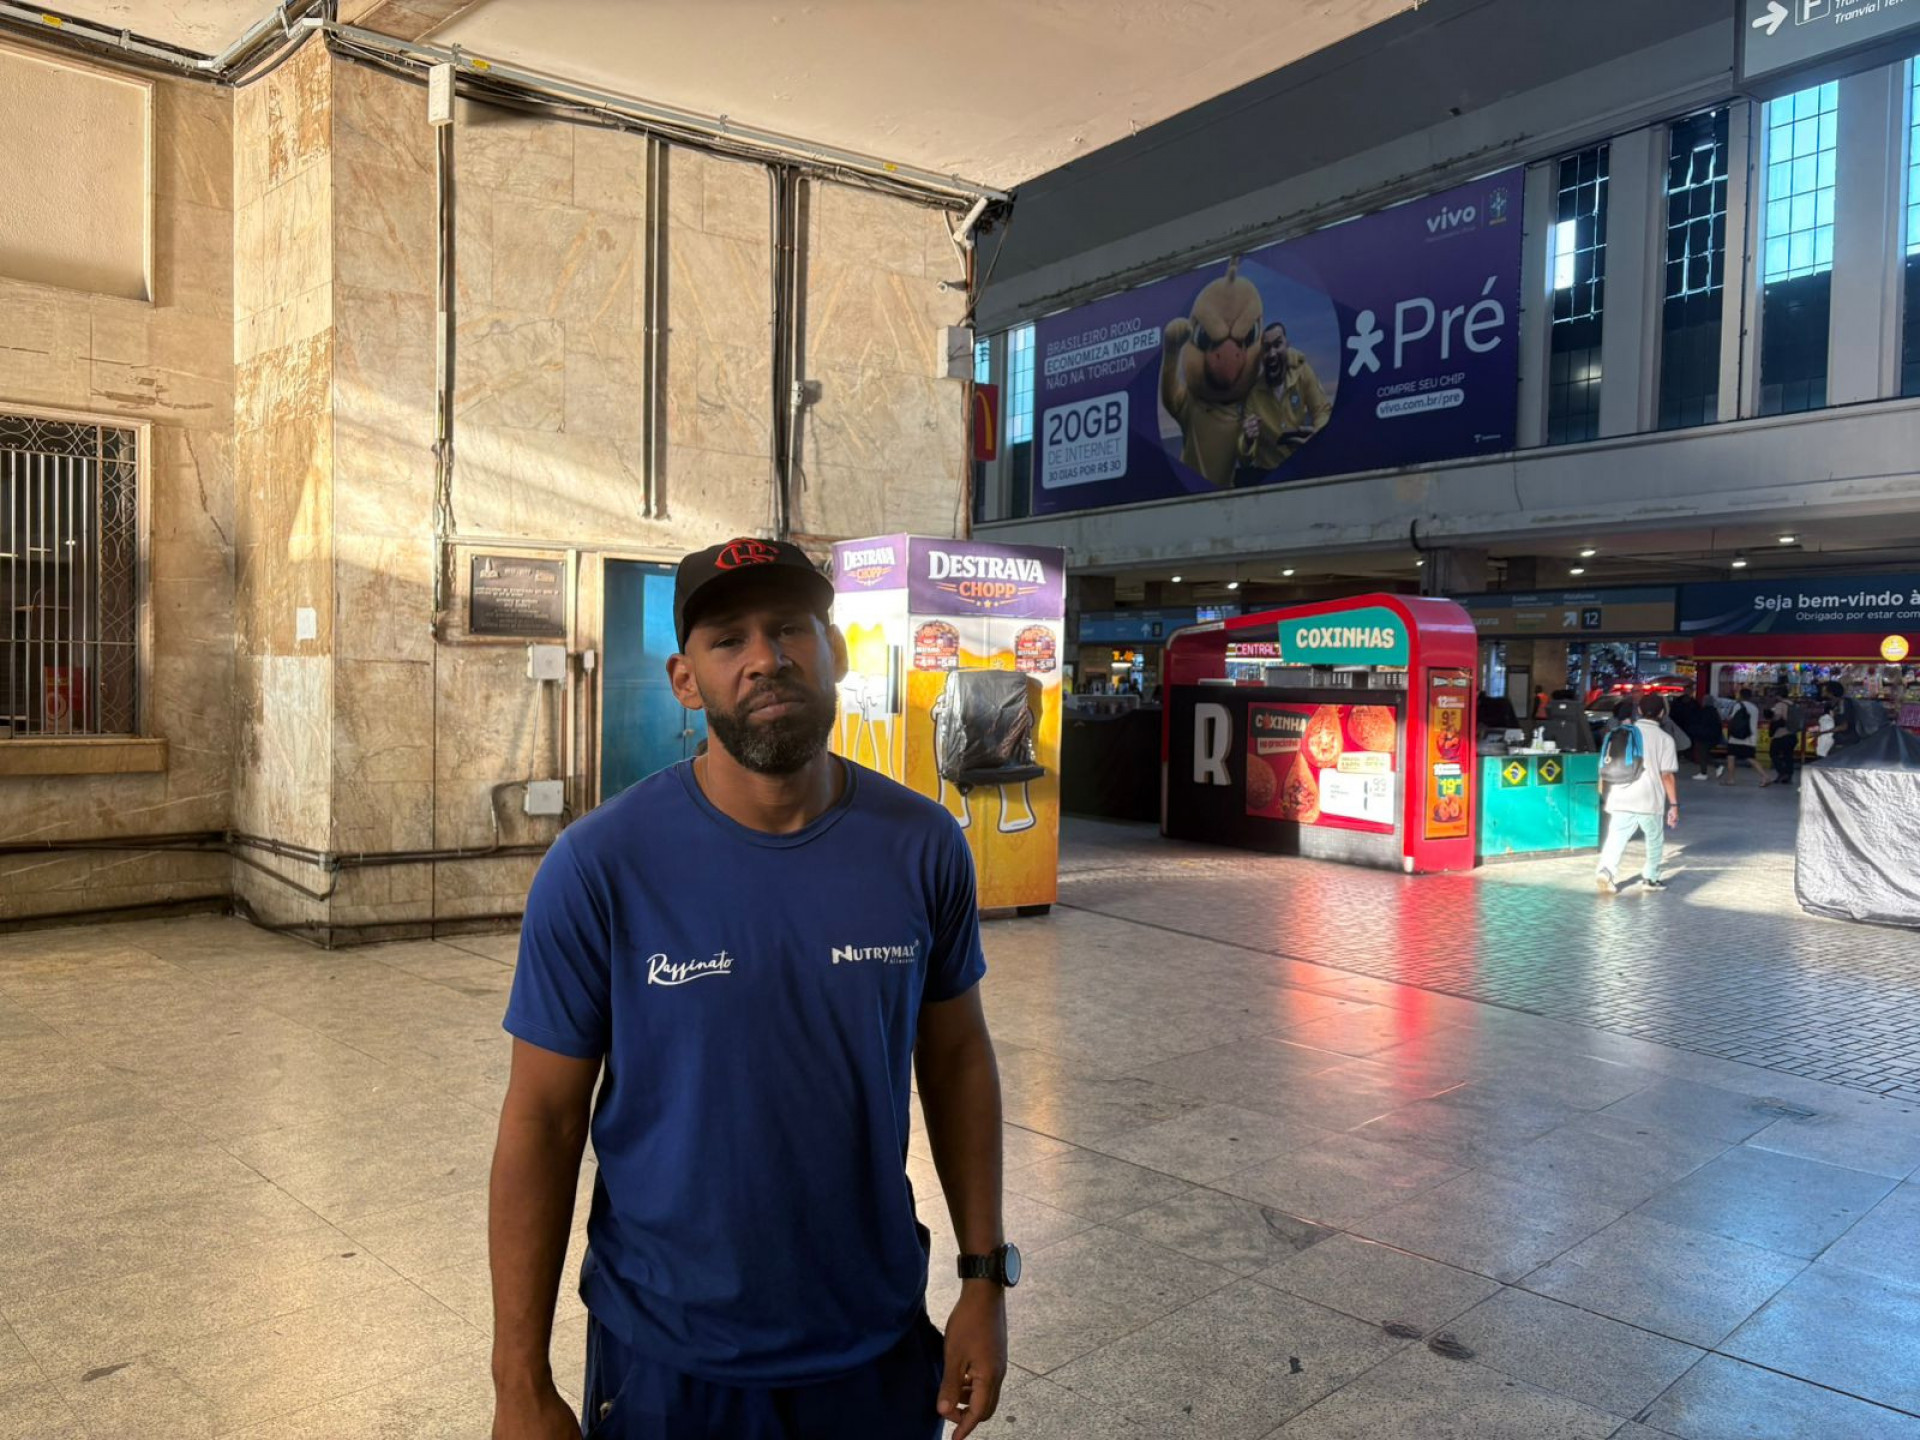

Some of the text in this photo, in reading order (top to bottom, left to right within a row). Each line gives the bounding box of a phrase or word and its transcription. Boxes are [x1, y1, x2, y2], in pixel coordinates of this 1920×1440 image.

[1835, 3, 1876, 24] Tranvía
[1426, 206, 1476, 233] vivo
[1394, 275, 1505, 369] Pré
[1047, 317, 1142, 356] BRASILEIRO ROXO
[1047, 345, 1109, 373] ECONOMIZA
[1113, 339, 1129, 353] NO
[1046, 355, 1136, 390] NÃO NA TORCIDA
[1376, 372, 1465, 398] COMPRE SEU CHIP
[1049, 401, 1122, 446] 20GB
[1047, 438, 1121, 465] DE INTERNET
[1060, 467, 1078, 480] DIAS
[1080, 463, 1097, 476] POR
[843, 547, 895, 570] DESTRAVA
[928, 551, 1046, 584] DESTRAVA
[959, 581, 1017, 598] CHOPP
[1754, 594, 1792, 611] Seja
[1798, 590, 1903, 608] bem-vindo
[1584, 612, 1598, 625] 12
[1796, 611, 1844, 621] Obrigado
[1846, 612, 1865, 621] por
[1867, 610, 1894, 619] estar
[1235, 643, 1276, 655] CENTRAL
[1296, 627, 1395, 648] COXINHAS
[1194, 703, 1233, 786] R
